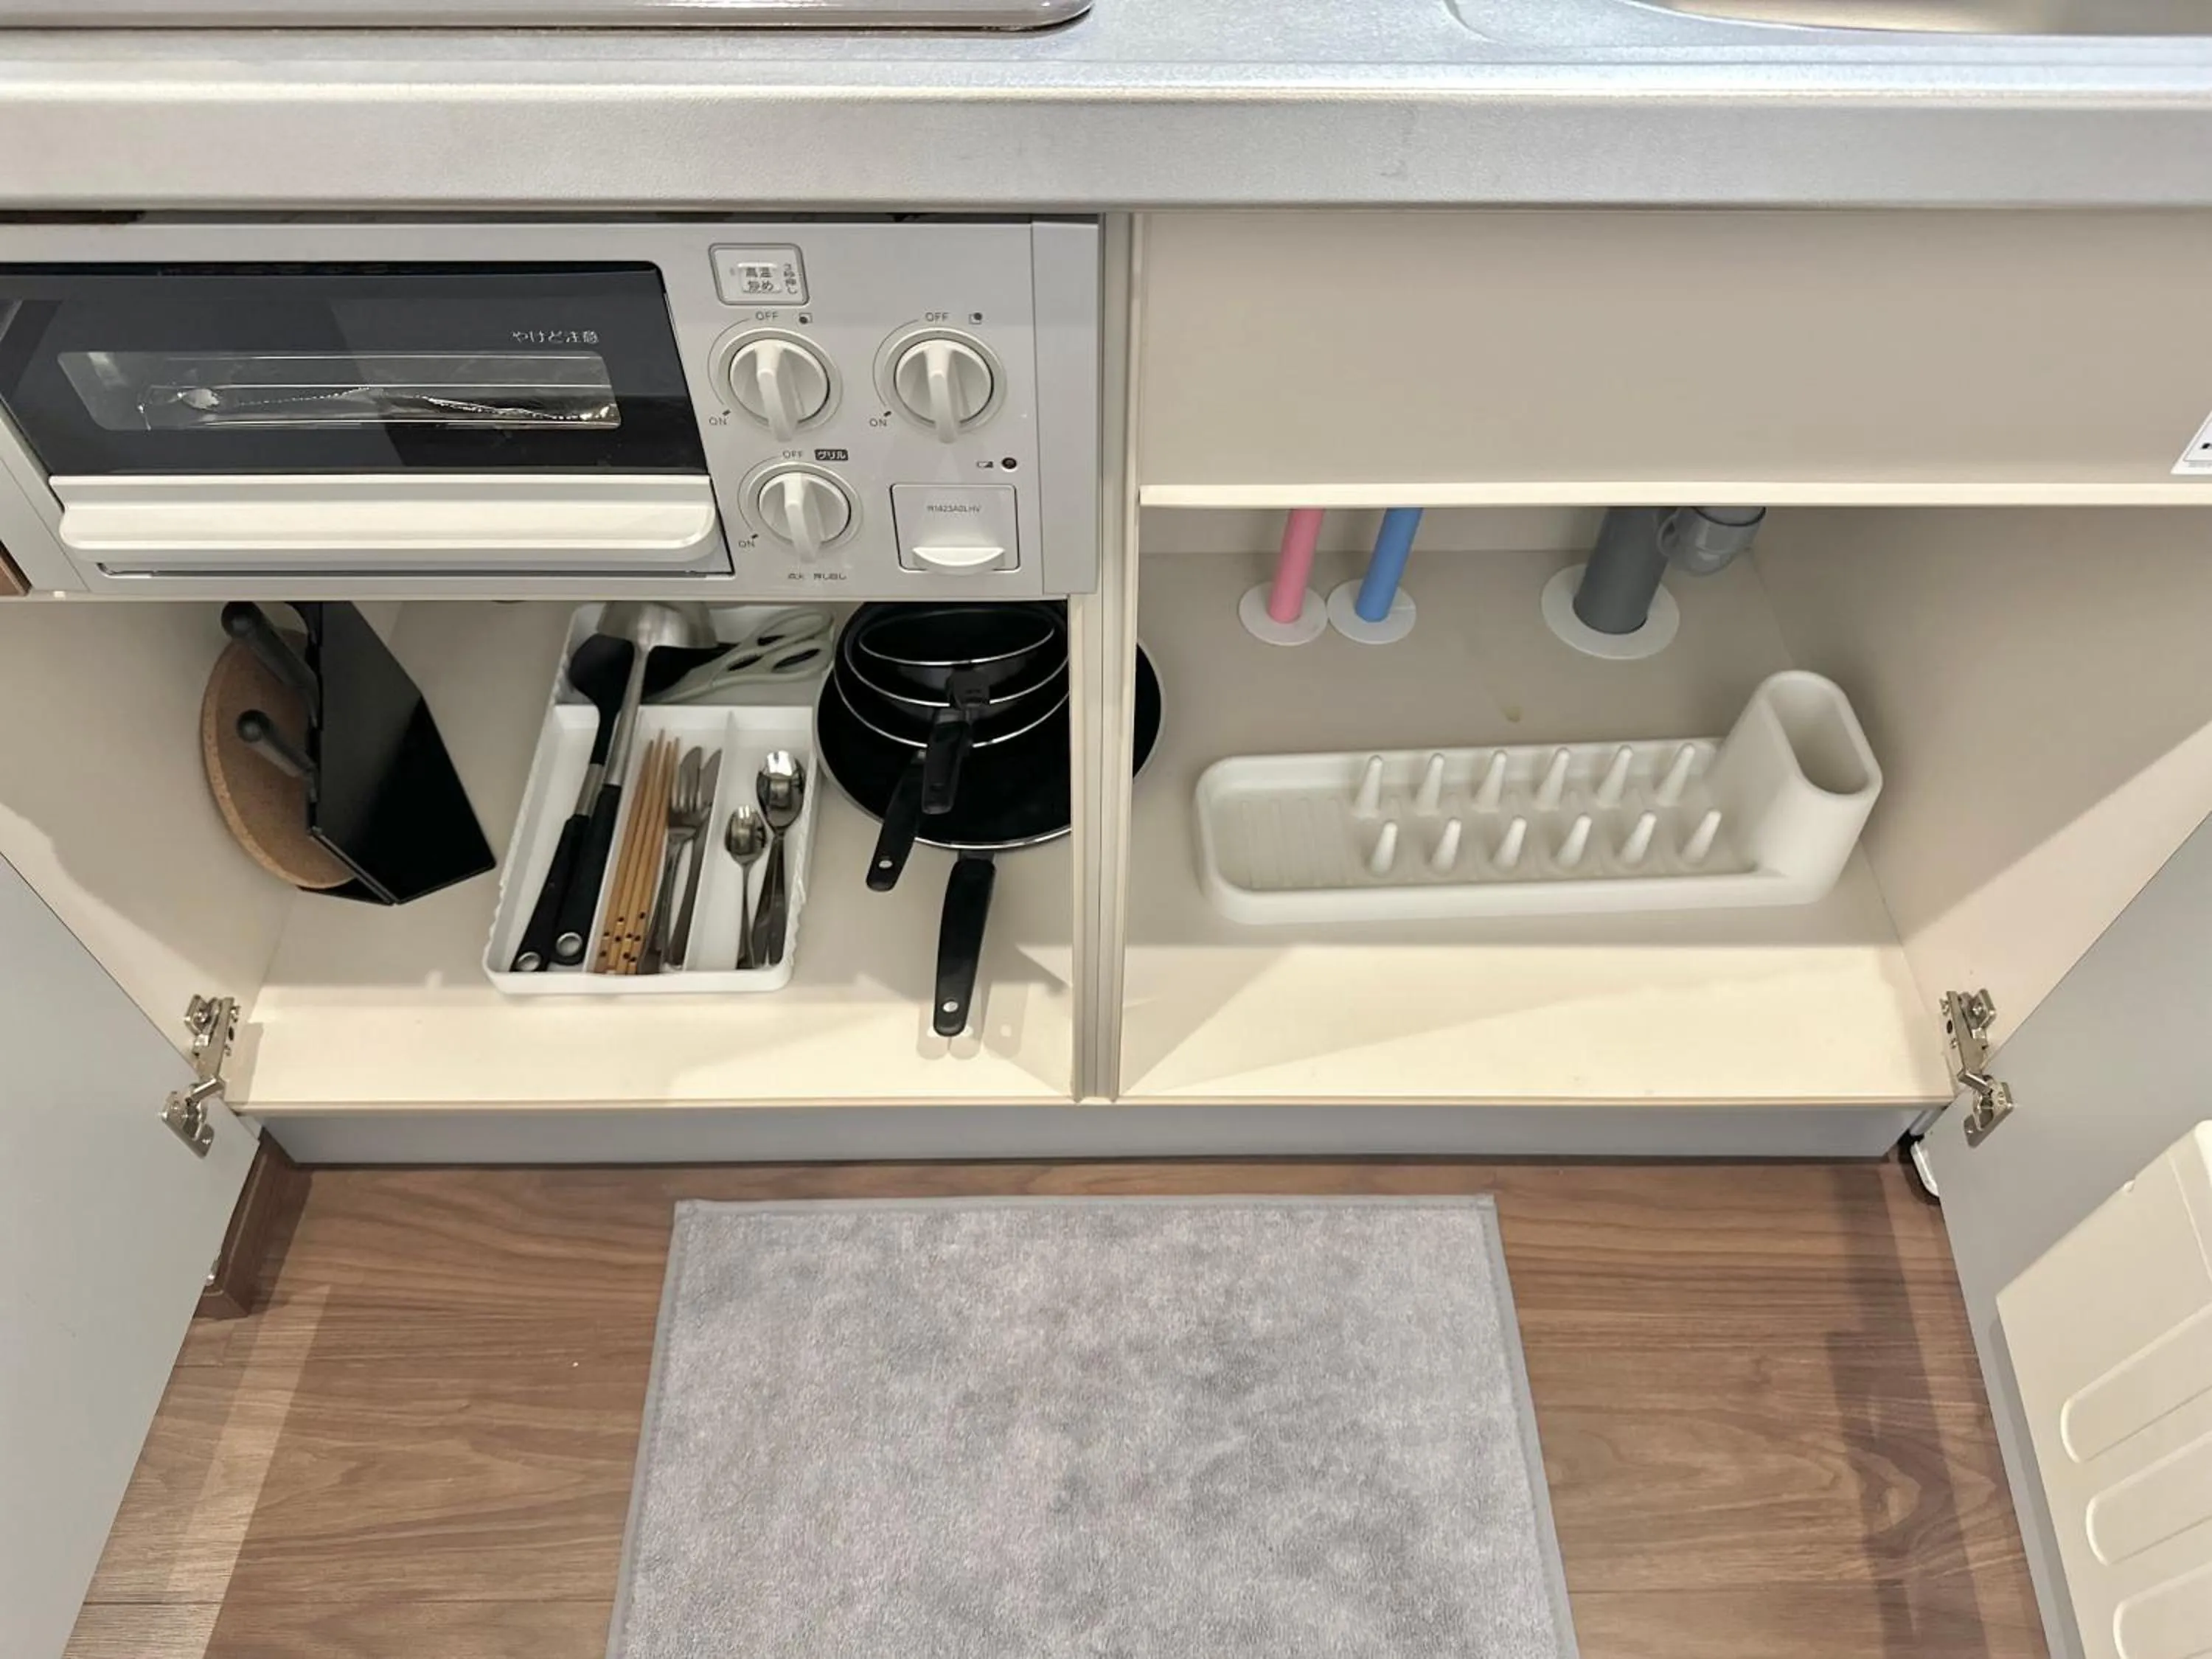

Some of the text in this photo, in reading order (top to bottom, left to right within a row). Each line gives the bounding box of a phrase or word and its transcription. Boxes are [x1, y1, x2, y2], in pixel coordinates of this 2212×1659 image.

[755, 311, 779, 321] OFF
[925, 312, 949, 321] OFF
[512, 330, 599, 344] やけど注意
[709, 416, 727, 425] ON
[869, 417, 887, 427] ON
[782, 450, 803, 459] OFF
